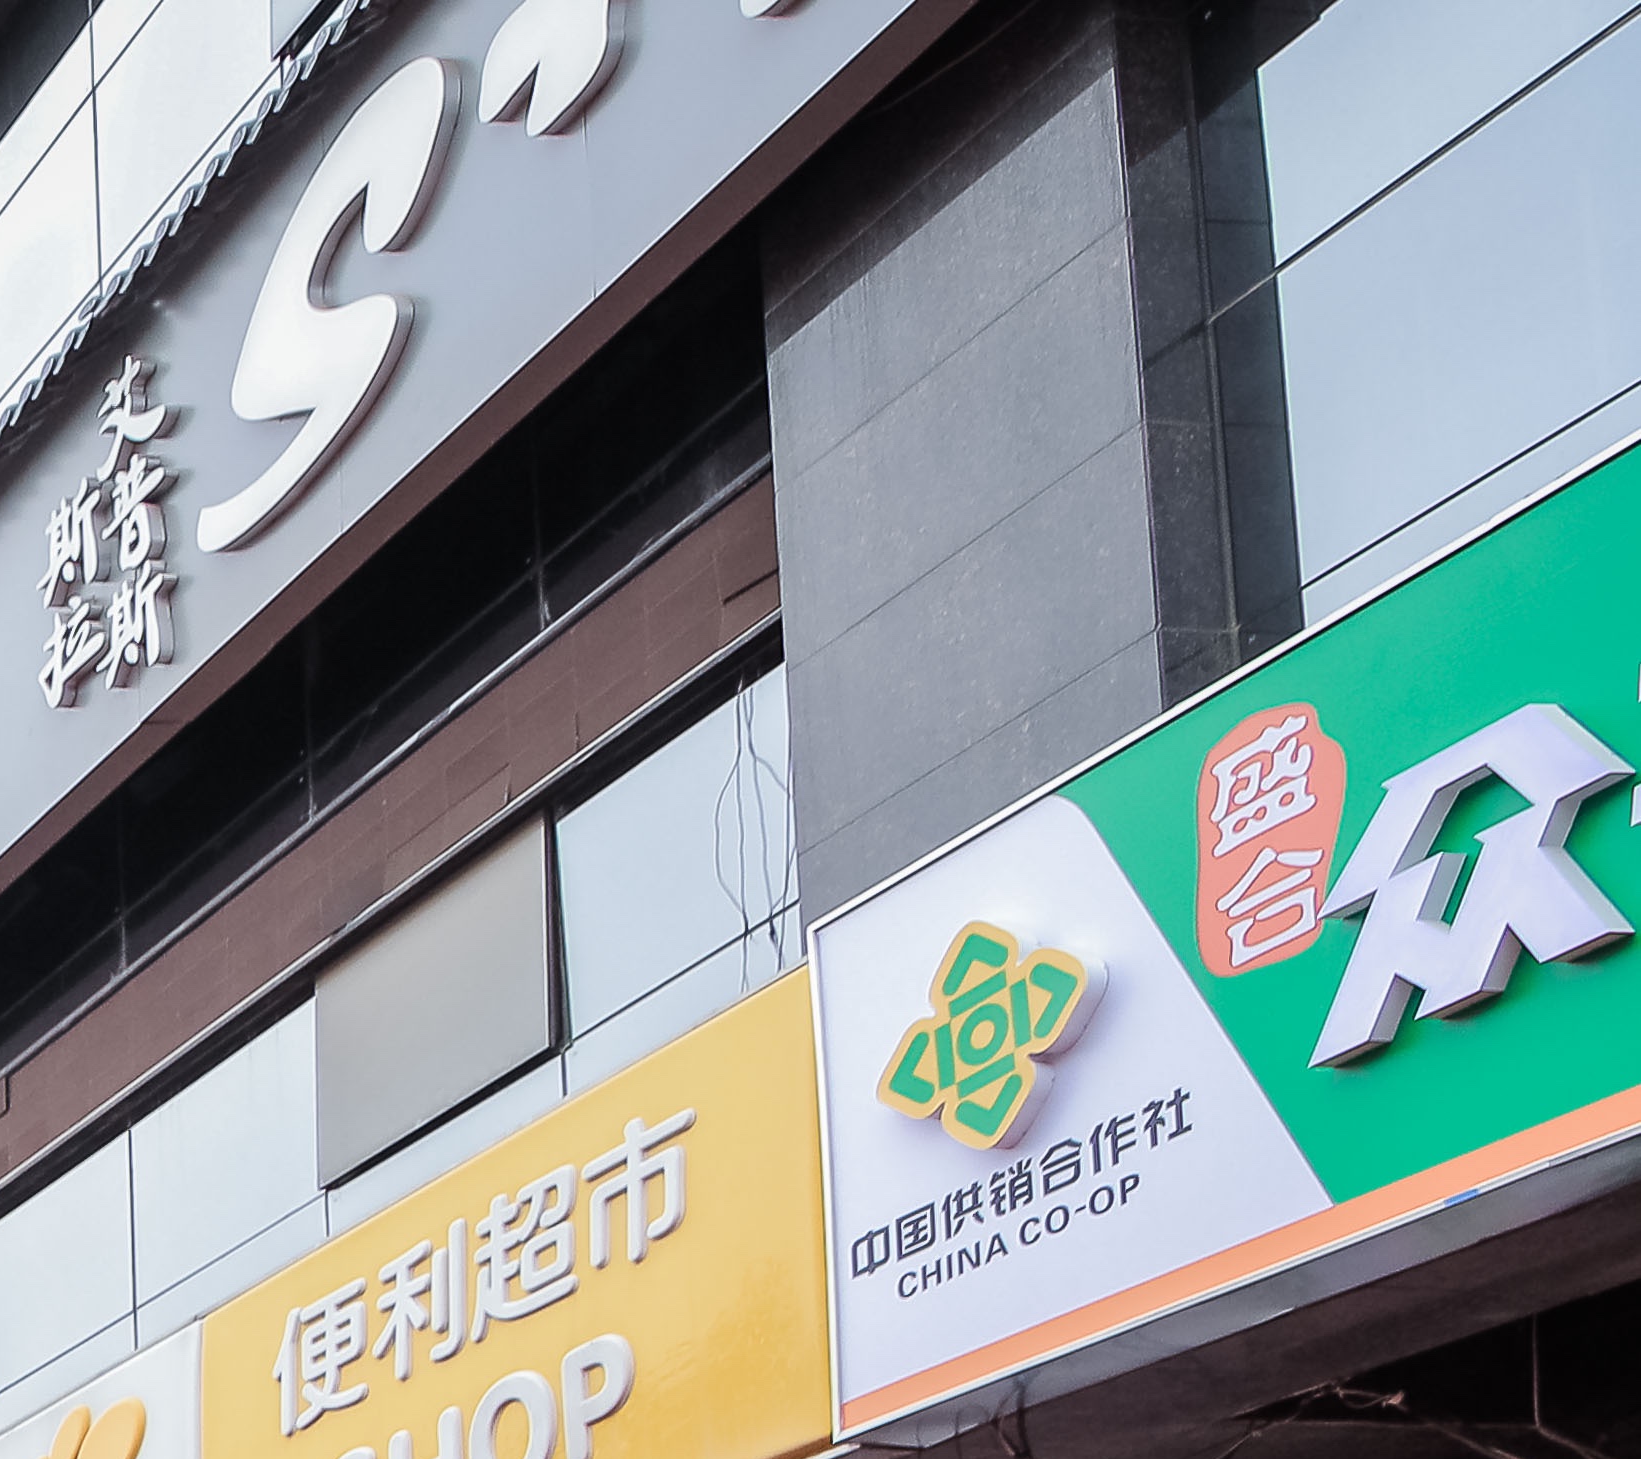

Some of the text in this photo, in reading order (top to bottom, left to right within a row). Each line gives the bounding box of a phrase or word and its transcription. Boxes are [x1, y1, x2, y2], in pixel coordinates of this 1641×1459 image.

[273, 1112, 690, 1438] 便利超市
[851, 1087, 1193, 1278] 中国供销合作社
[897, 1174, 1141, 1300] CHINA CO-OP
